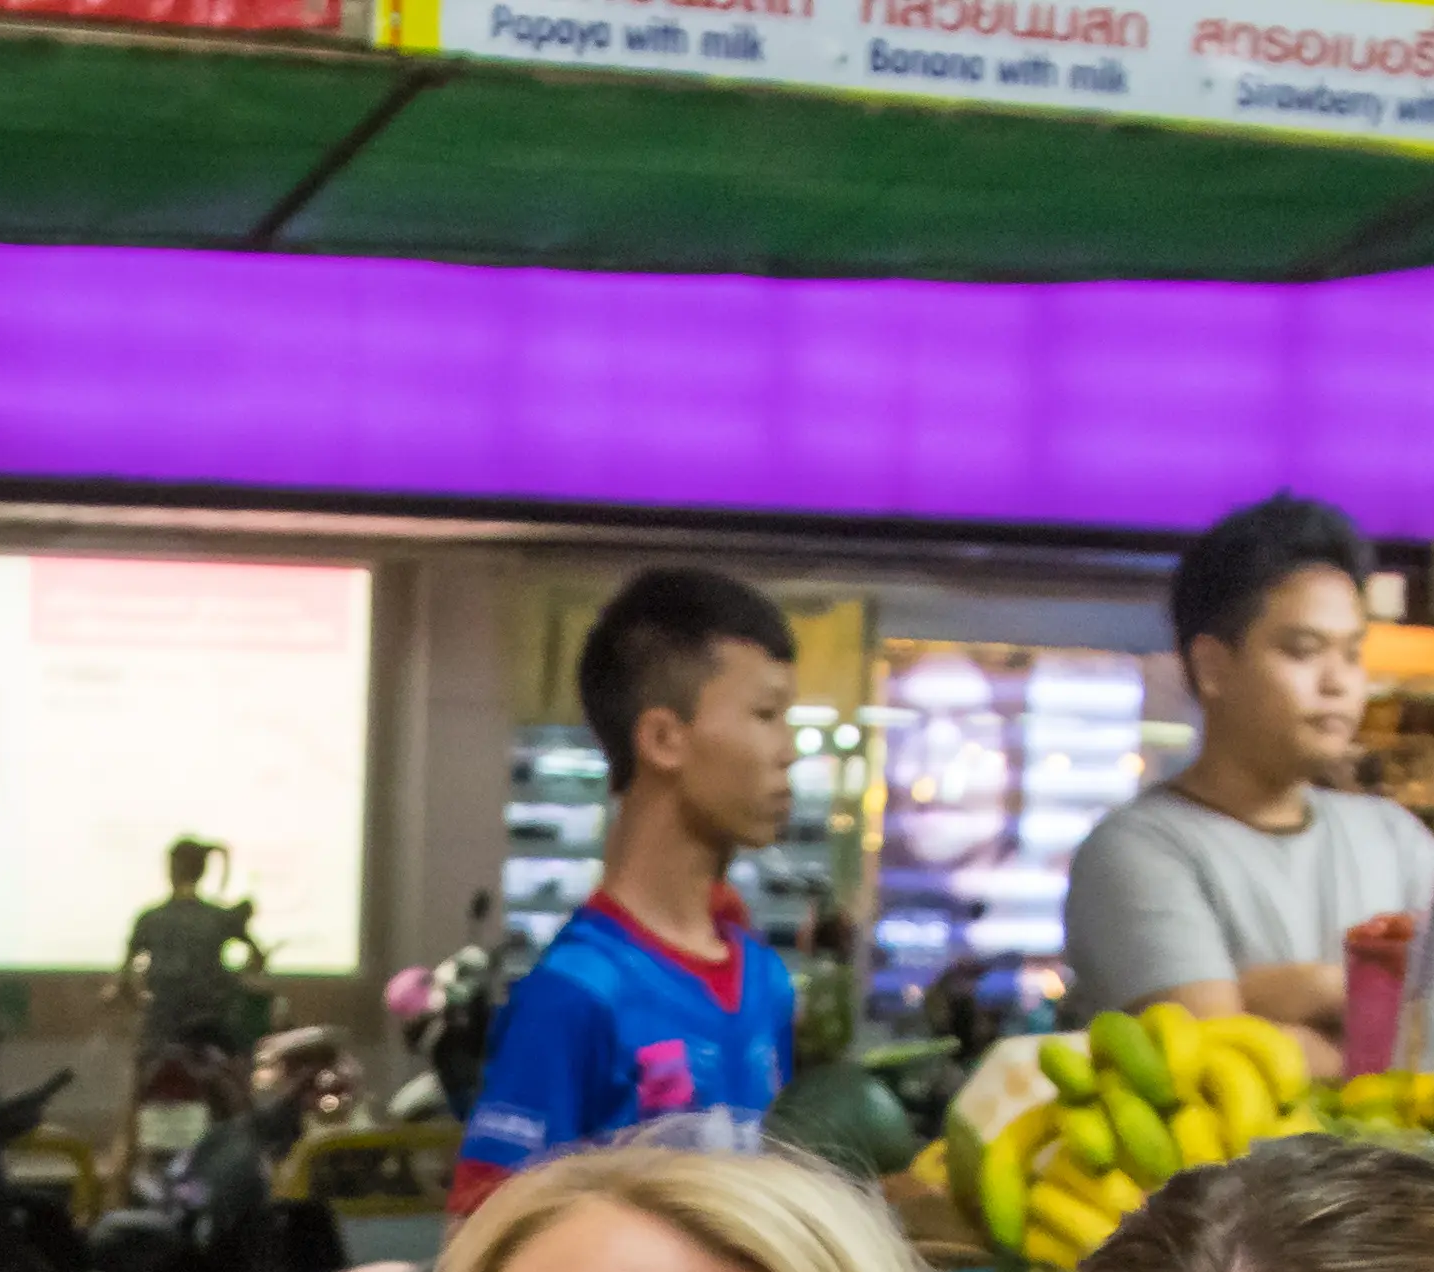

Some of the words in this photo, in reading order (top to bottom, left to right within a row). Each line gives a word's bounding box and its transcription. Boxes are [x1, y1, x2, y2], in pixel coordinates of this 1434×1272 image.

[491, 4, 612, 55] Papaya
[625, 16, 689, 54] with
[701, 23, 765, 61] milk
[868, 38, 986, 80] Banana
[996, 50, 1058, 86] with
[1068, 56, 1128, 93] milk
